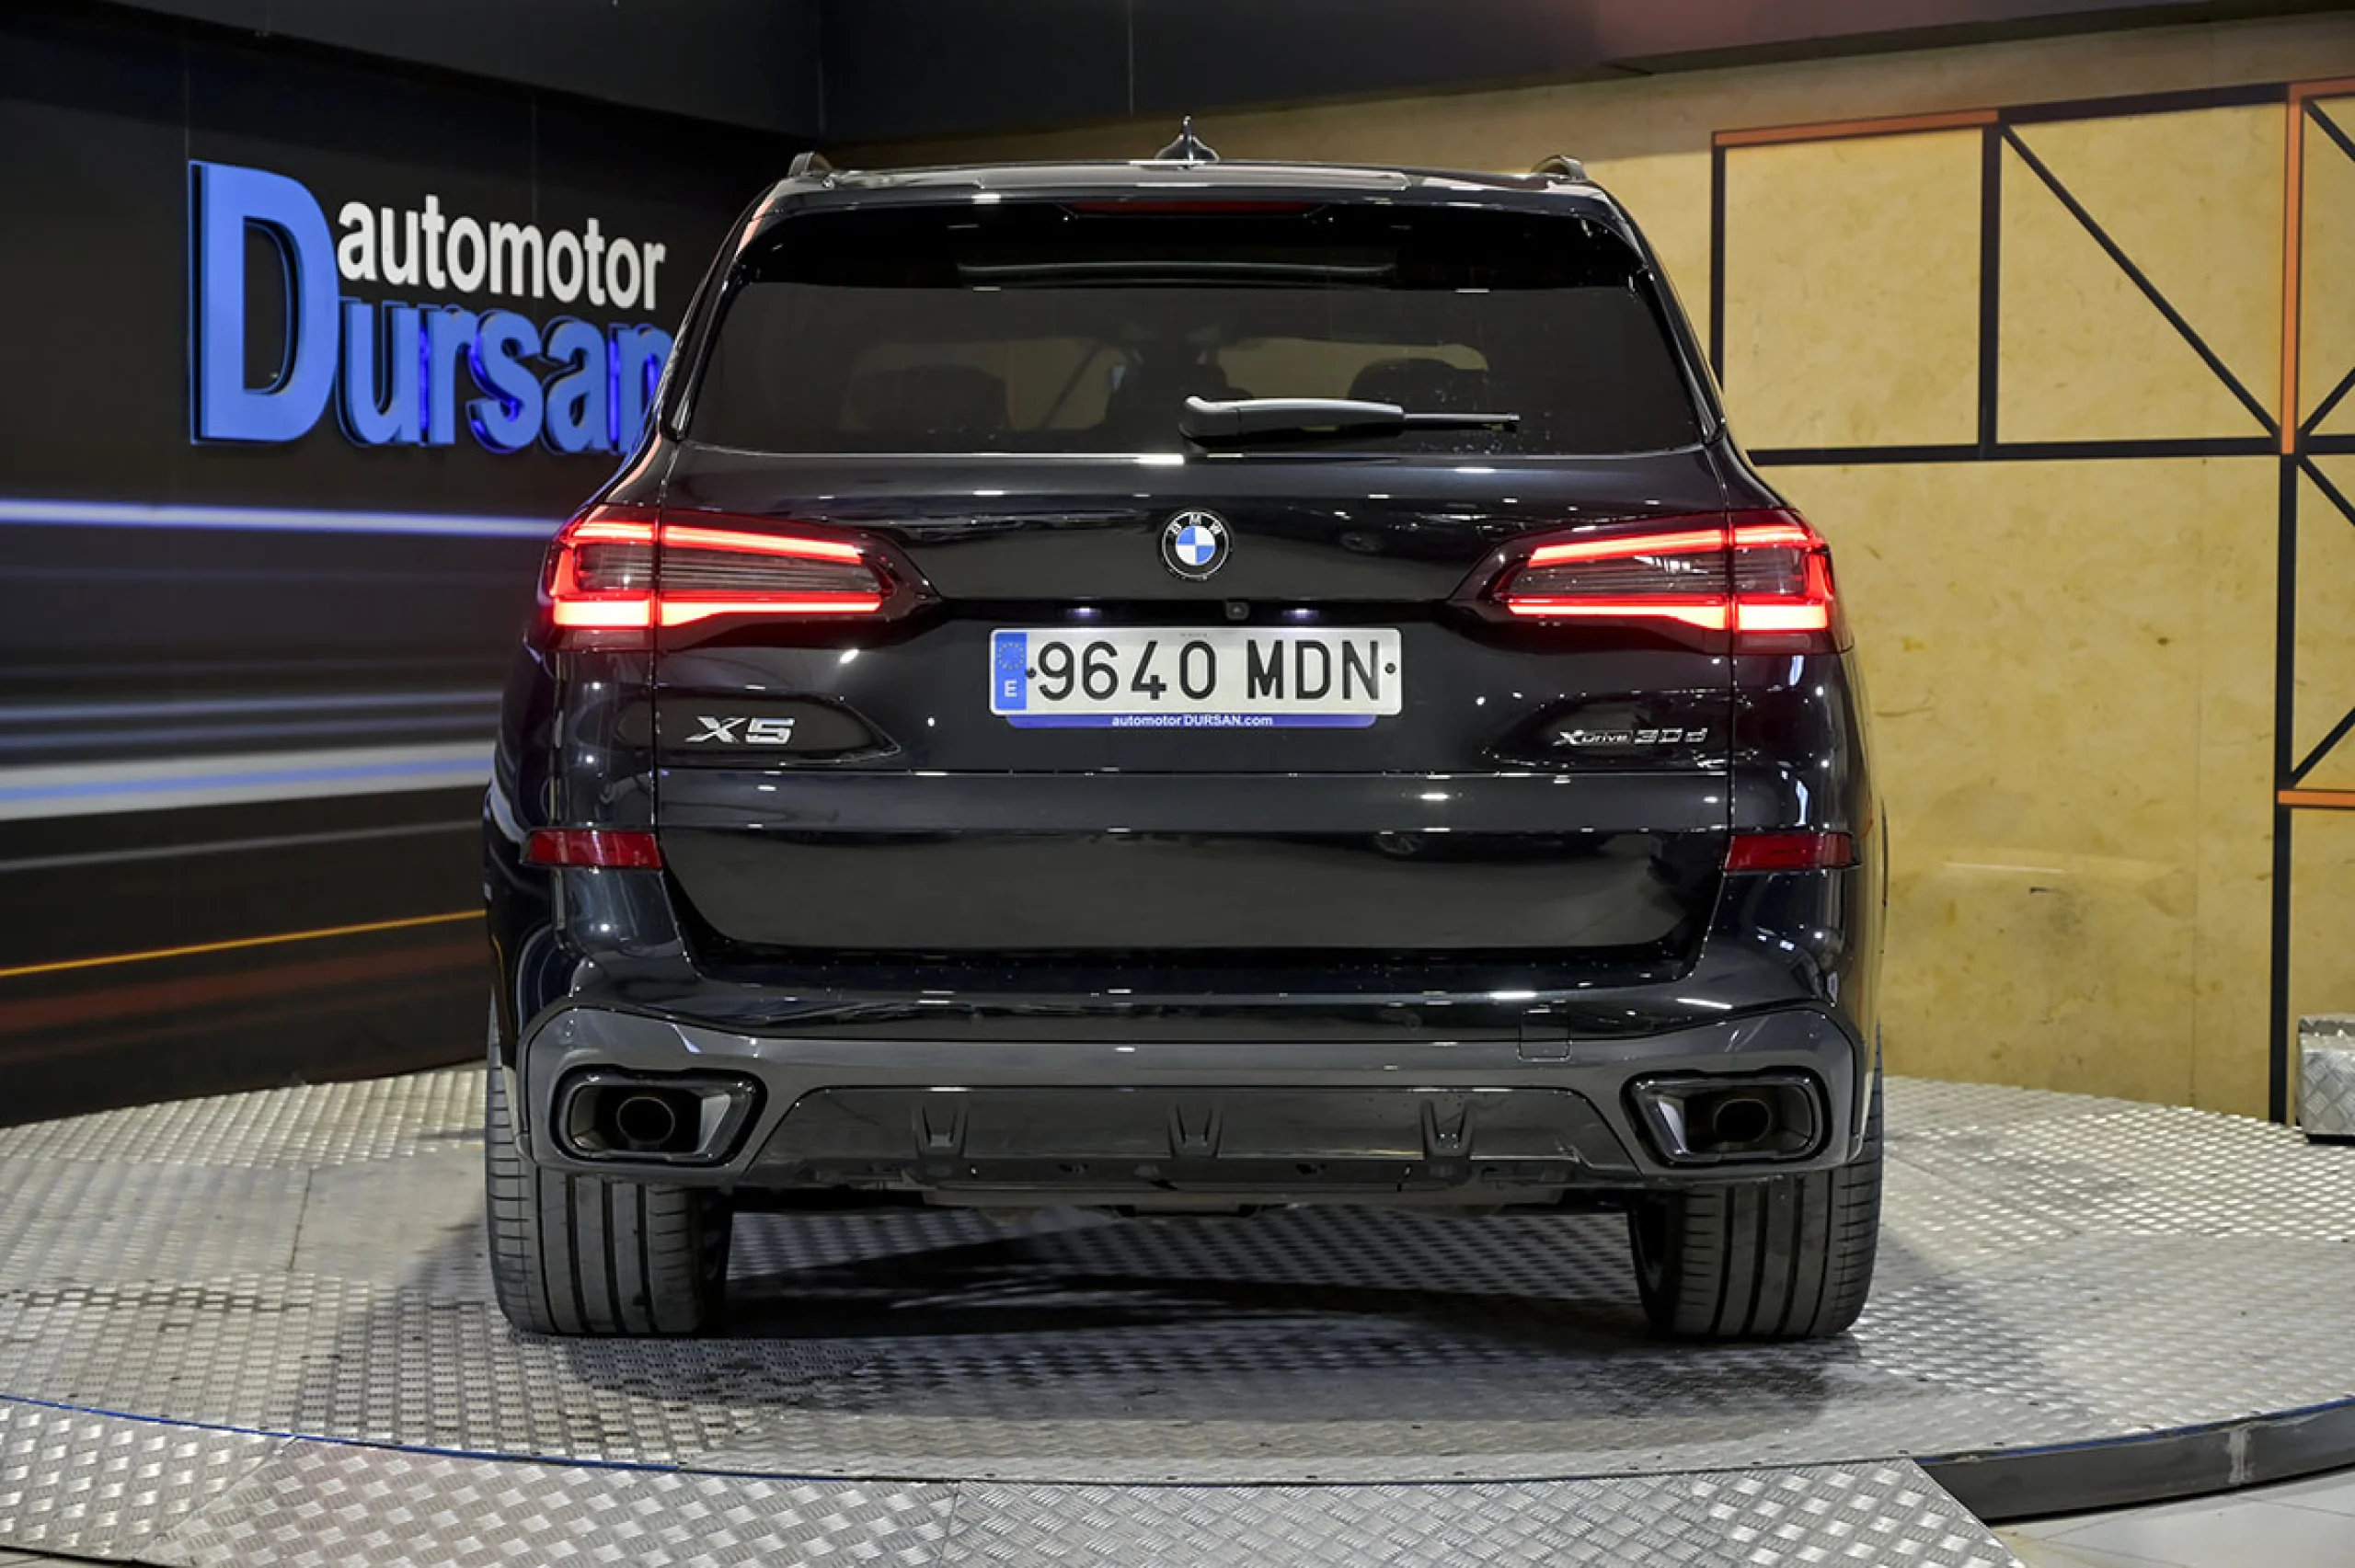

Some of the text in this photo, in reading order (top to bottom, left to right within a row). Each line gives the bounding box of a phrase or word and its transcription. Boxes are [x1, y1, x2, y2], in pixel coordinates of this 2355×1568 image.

[337, 194, 666, 310] automotor
[1038, 639, 1379, 701] 9640 MDN
[1004, 680, 1017, 697] E
[684, 715, 796, 744] X5
[1111, 715, 1182, 727] automotor
